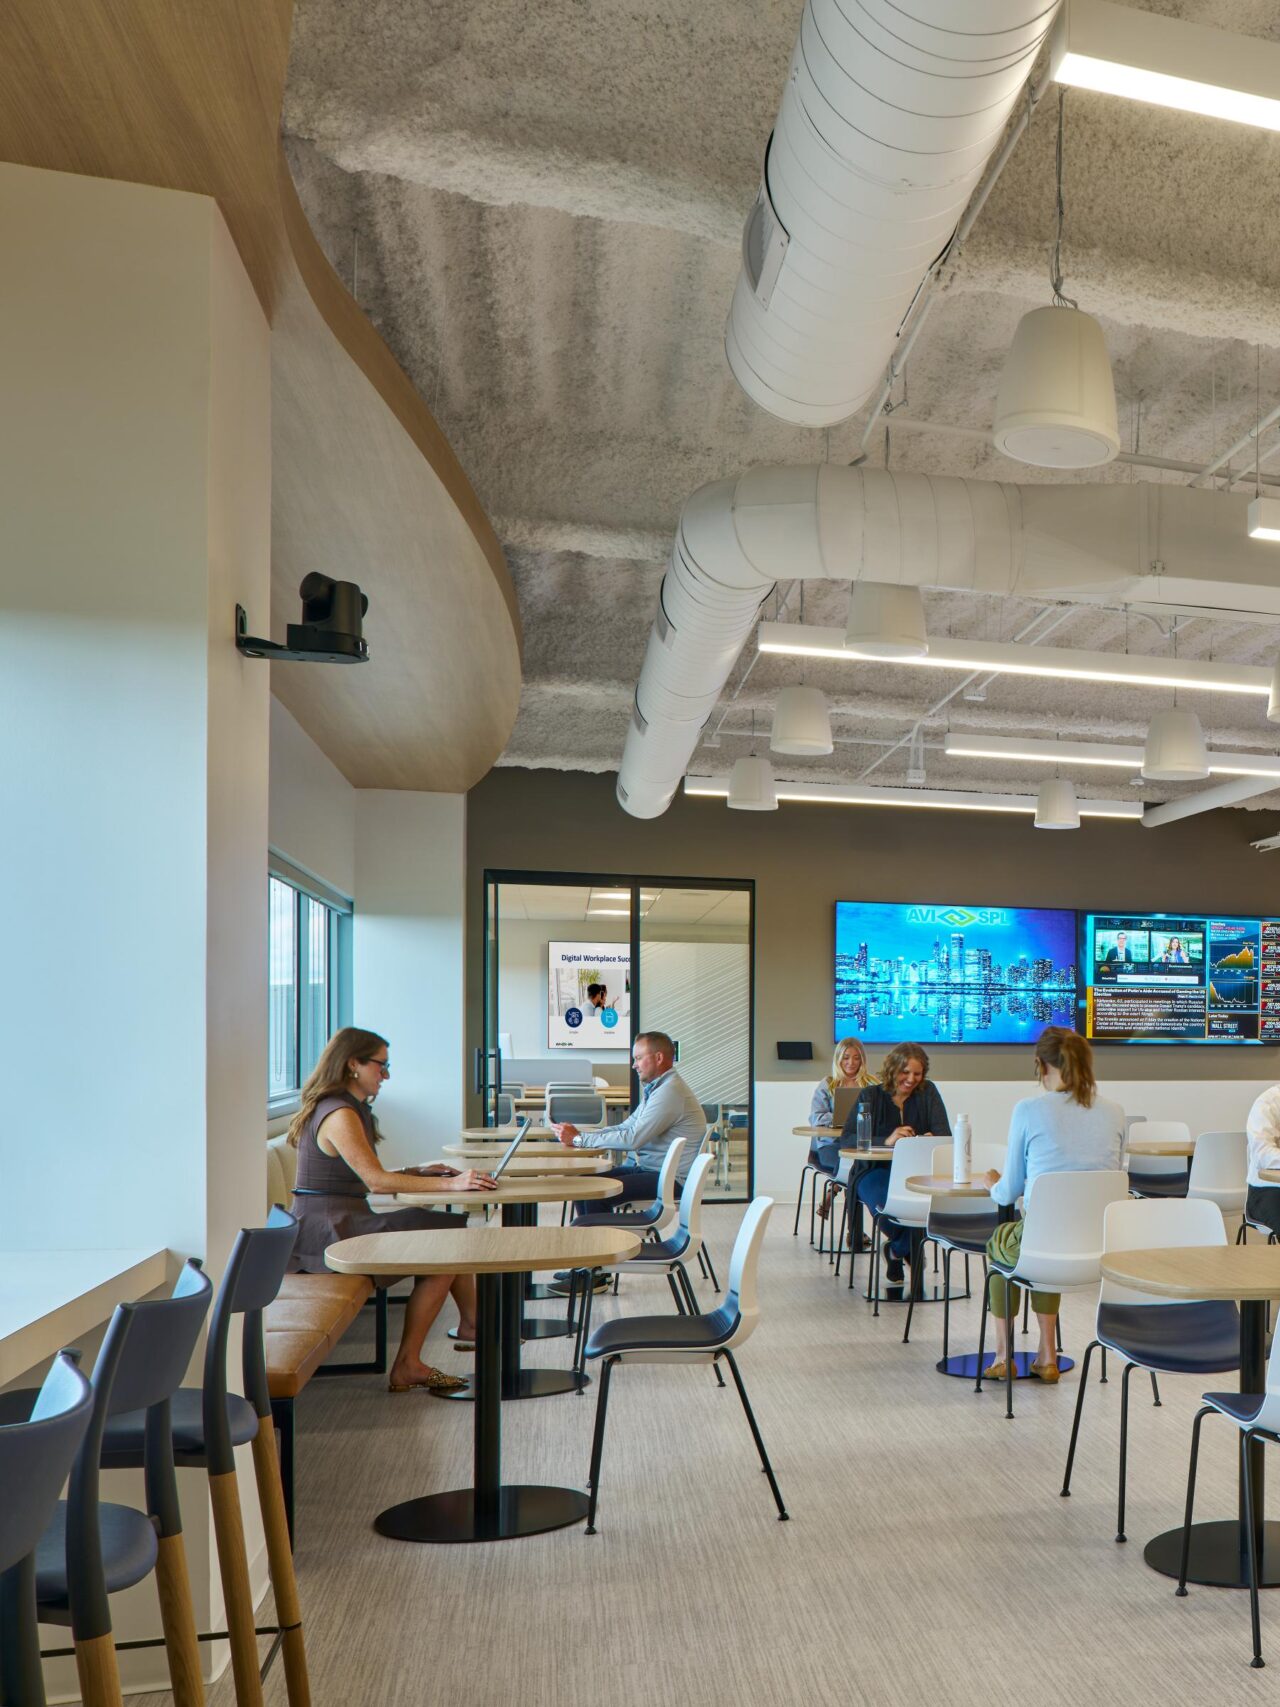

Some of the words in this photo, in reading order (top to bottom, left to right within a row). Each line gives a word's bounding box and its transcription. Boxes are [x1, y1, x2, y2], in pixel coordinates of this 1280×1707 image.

[907, 909, 936, 923] AVI
[978, 911, 1010, 926] SPL
[561, 954, 582, 963] Digital
[583, 955, 617, 963] Workplace
